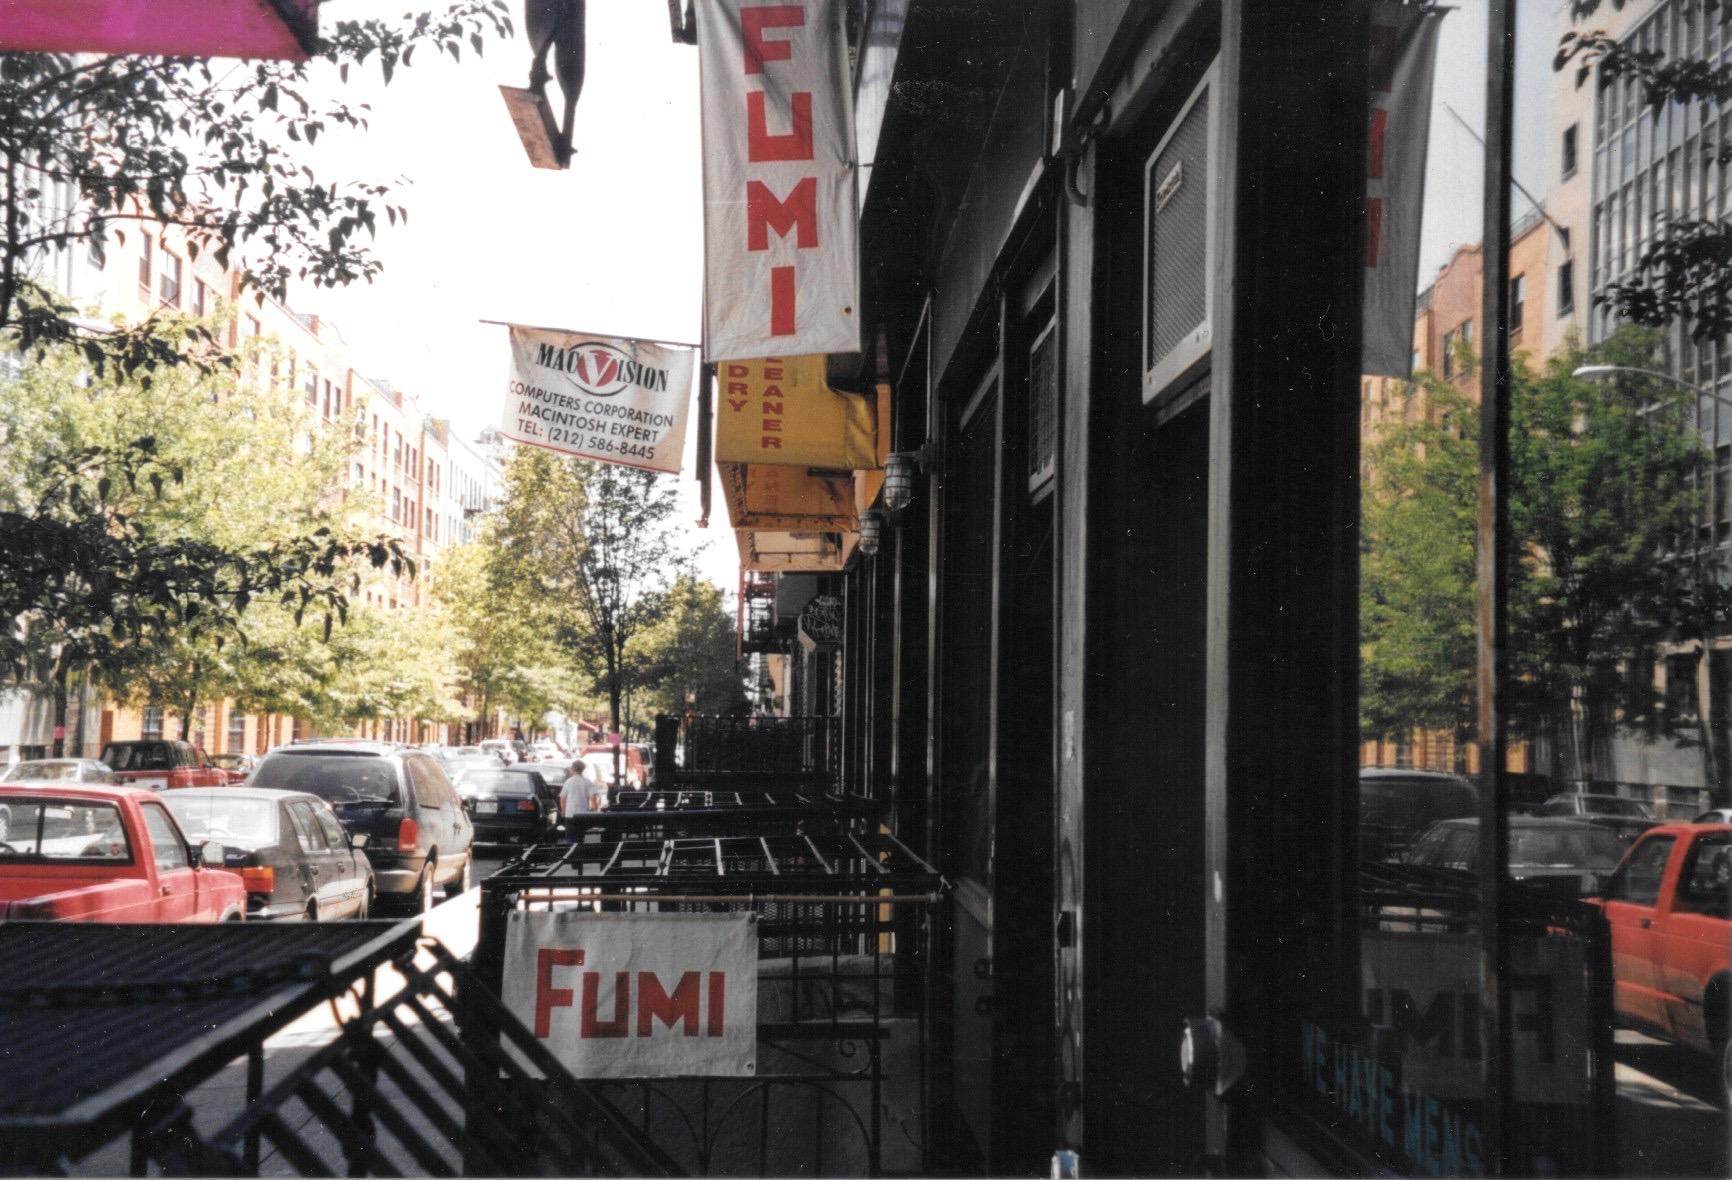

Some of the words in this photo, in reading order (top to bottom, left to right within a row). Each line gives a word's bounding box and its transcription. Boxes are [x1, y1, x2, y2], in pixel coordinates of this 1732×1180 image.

[740, 6, 819, 336] FUMI
[510, 380, 581, 411] COMPUTERS
[585, 400, 673, 427] CORPORATION
[518, 401, 606, 433] MACINTOSH
[610, 423, 659, 443] EXPERT
[761, 357, 784, 449] EANER
[518, 419, 543, 437] TEL:
[548, 426, 584, 448] (212)
[588, 437, 655, 460] 586-8445
[534, 948, 725, 1038] FUMI
